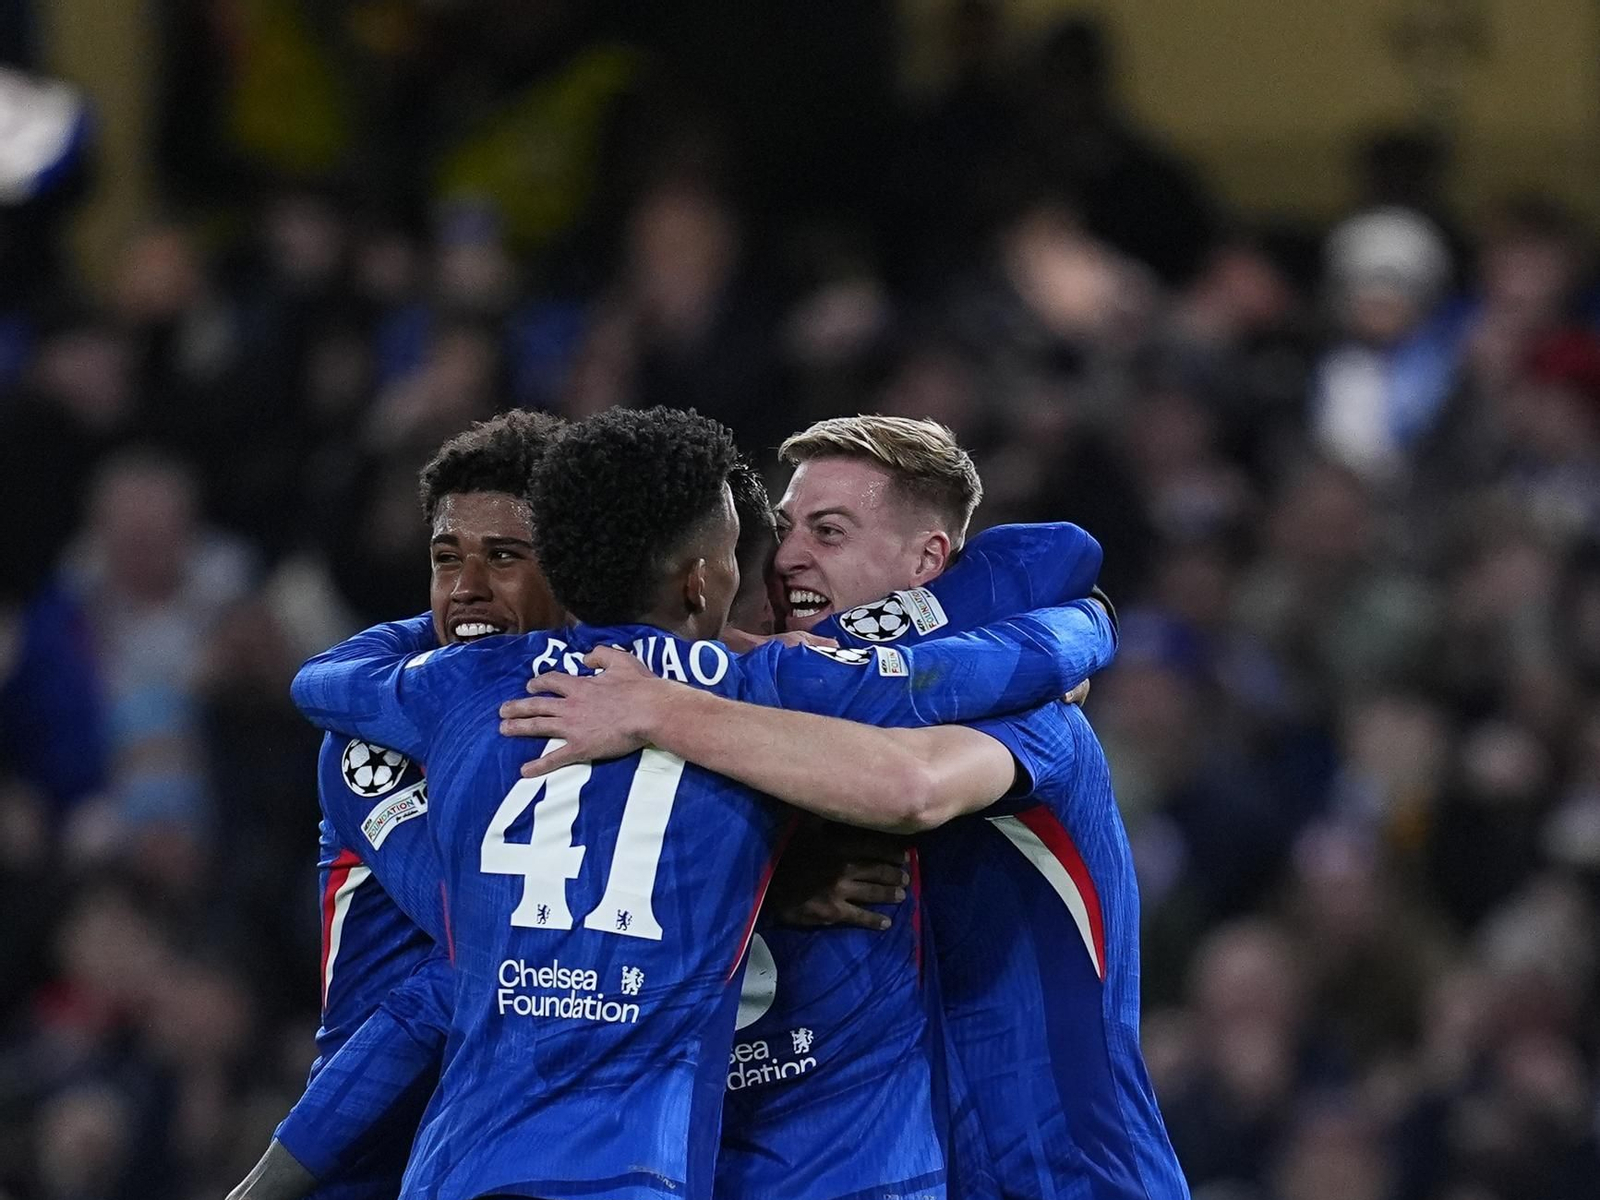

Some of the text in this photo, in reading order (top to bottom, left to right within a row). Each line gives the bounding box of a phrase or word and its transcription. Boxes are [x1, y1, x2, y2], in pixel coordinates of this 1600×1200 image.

[532, 637, 729, 686] ESVAO
[367, 799, 415, 840] FOUNDATION
[480, 738, 685, 941] 41
[498, 959, 598, 991] Chelsea
[498, 988, 640, 1023] Foundation
[727, 1056, 817, 1091] dation
